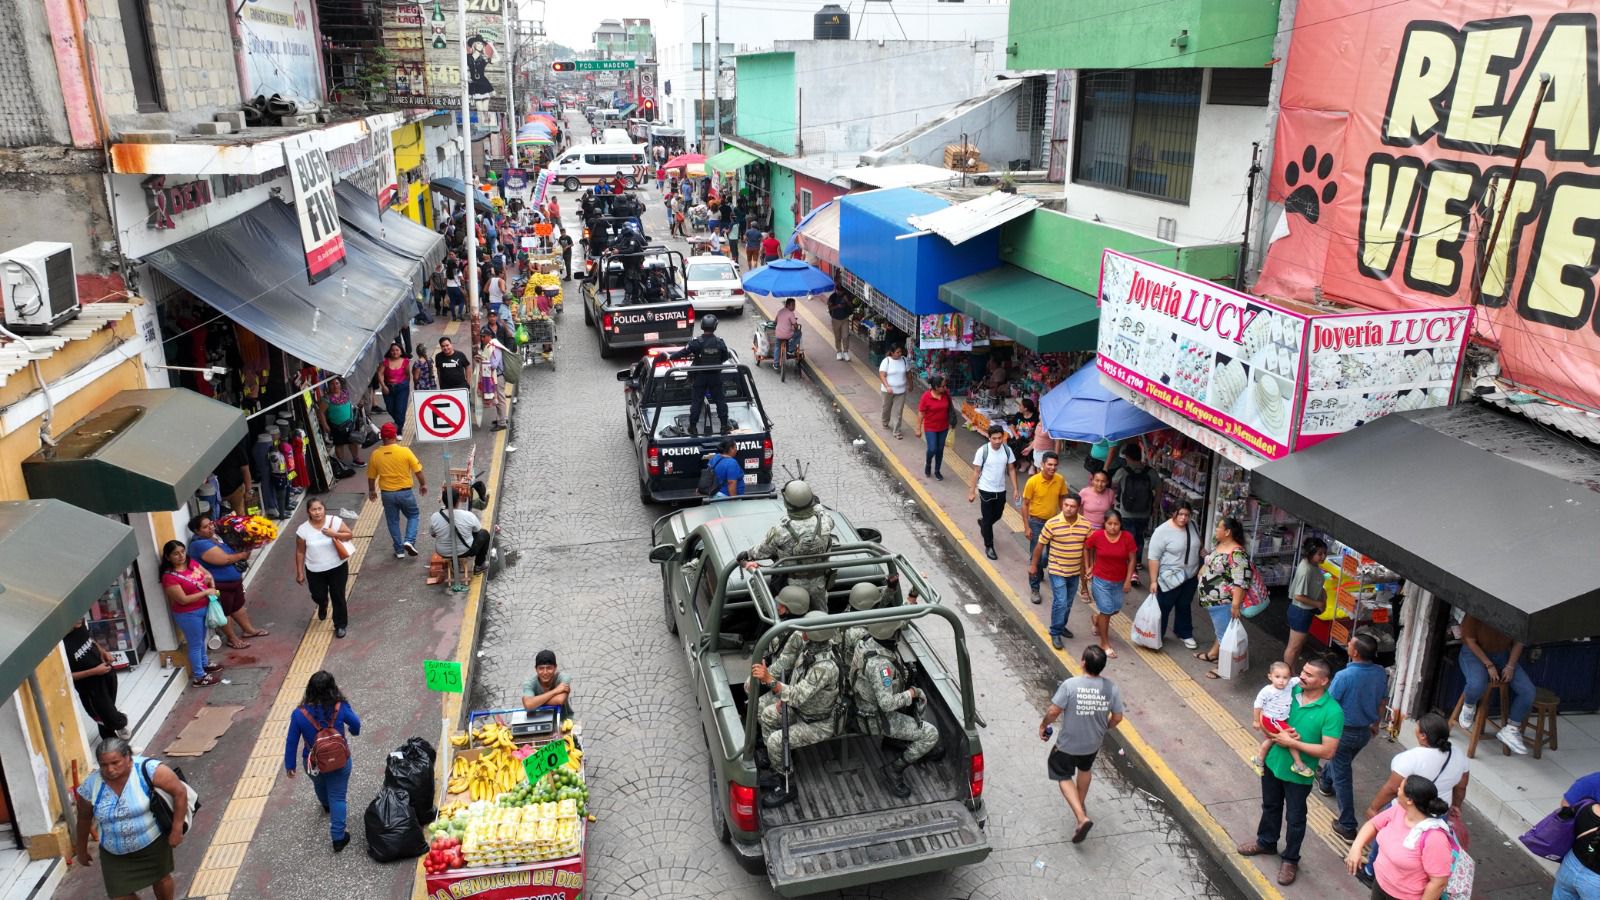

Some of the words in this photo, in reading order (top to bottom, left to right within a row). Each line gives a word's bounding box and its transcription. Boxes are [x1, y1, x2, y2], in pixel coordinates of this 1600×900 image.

[397, 15, 426, 24] LAGER
[399, 5, 424, 14] MEGA
[391, 95, 408, 104] LUNES
[415, 97, 433, 105] JUEVES
[1381, 12, 1600, 166] REA
[295, 147, 330, 193] BUEN
[1357, 152, 1600, 334] VETE
[613, 314, 646, 325] POLICIA
[654, 310, 687, 321] ESTATAL
[1126, 270, 1182, 319] Joyería
[1181, 288, 1257, 345] LUCY
[1312, 320, 1383, 353] Joyería
[1386, 316, 1466, 346] LUCY
[1145, 381, 1172, 404] ¡Venta
[1172, 395, 1184, 409] de
[1184, 400, 1224, 428] Mayoreo
[1224, 421, 1232, 433] y
[1232, 422, 1277, 457] Menudeo!
[661, 446, 700, 456] POLICIA
[735, 440, 763, 451] TATAL
[449, 870, 530, 899] BENDICION
[533, 868, 554, 886] DE
